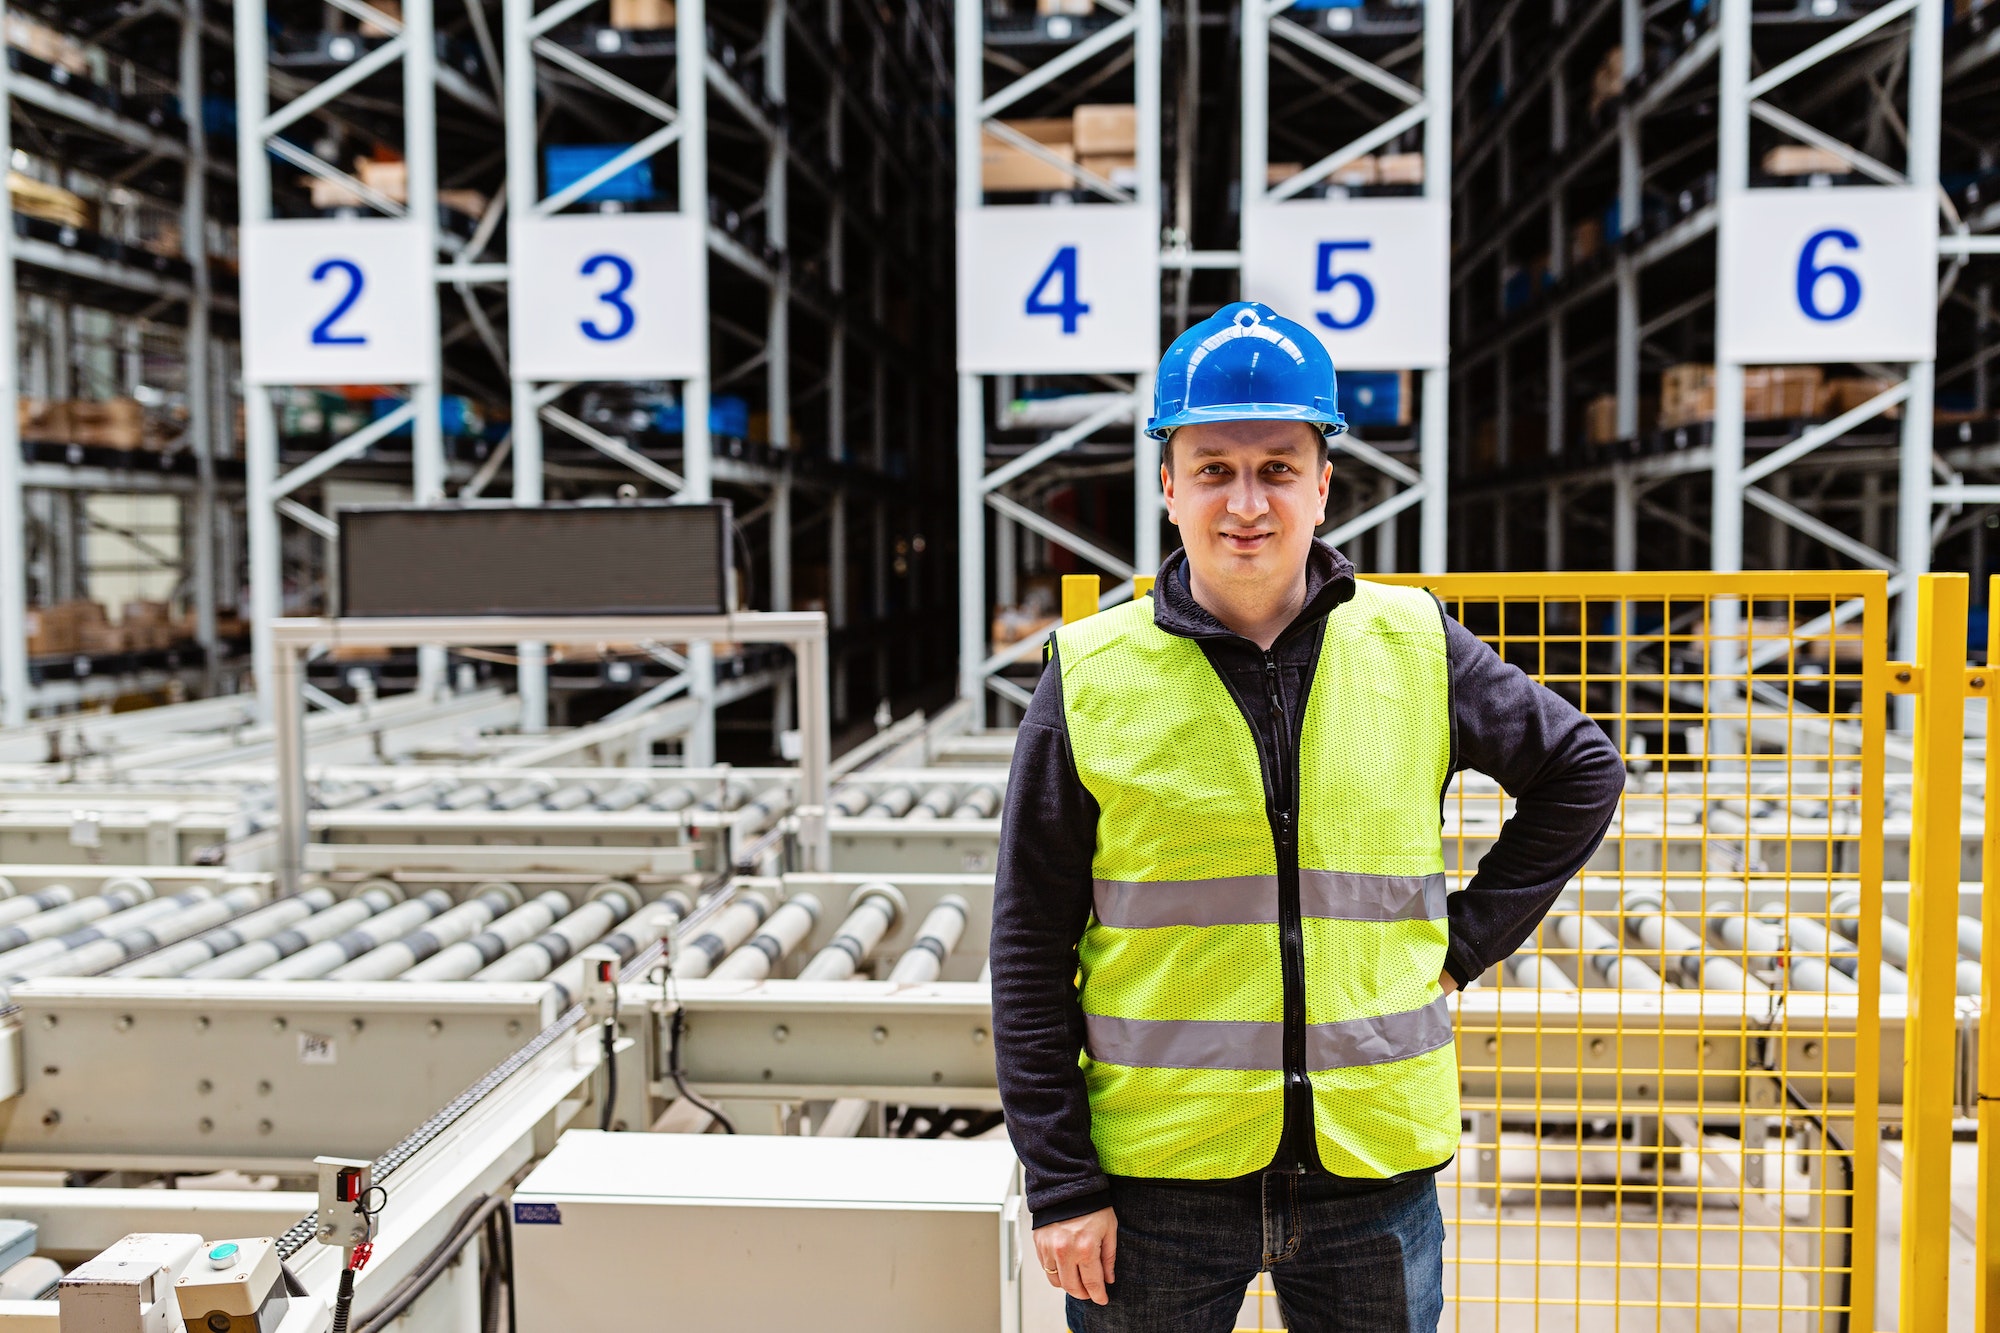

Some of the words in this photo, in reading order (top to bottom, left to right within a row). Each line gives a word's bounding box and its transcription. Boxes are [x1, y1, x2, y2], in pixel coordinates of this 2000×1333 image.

[310, 258, 367, 346] 2
[579, 253, 636, 343] 3
[1024, 245, 1091, 335] 4
[1314, 240, 1376, 331] 5
[1795, 228, 1863, 323] 6
